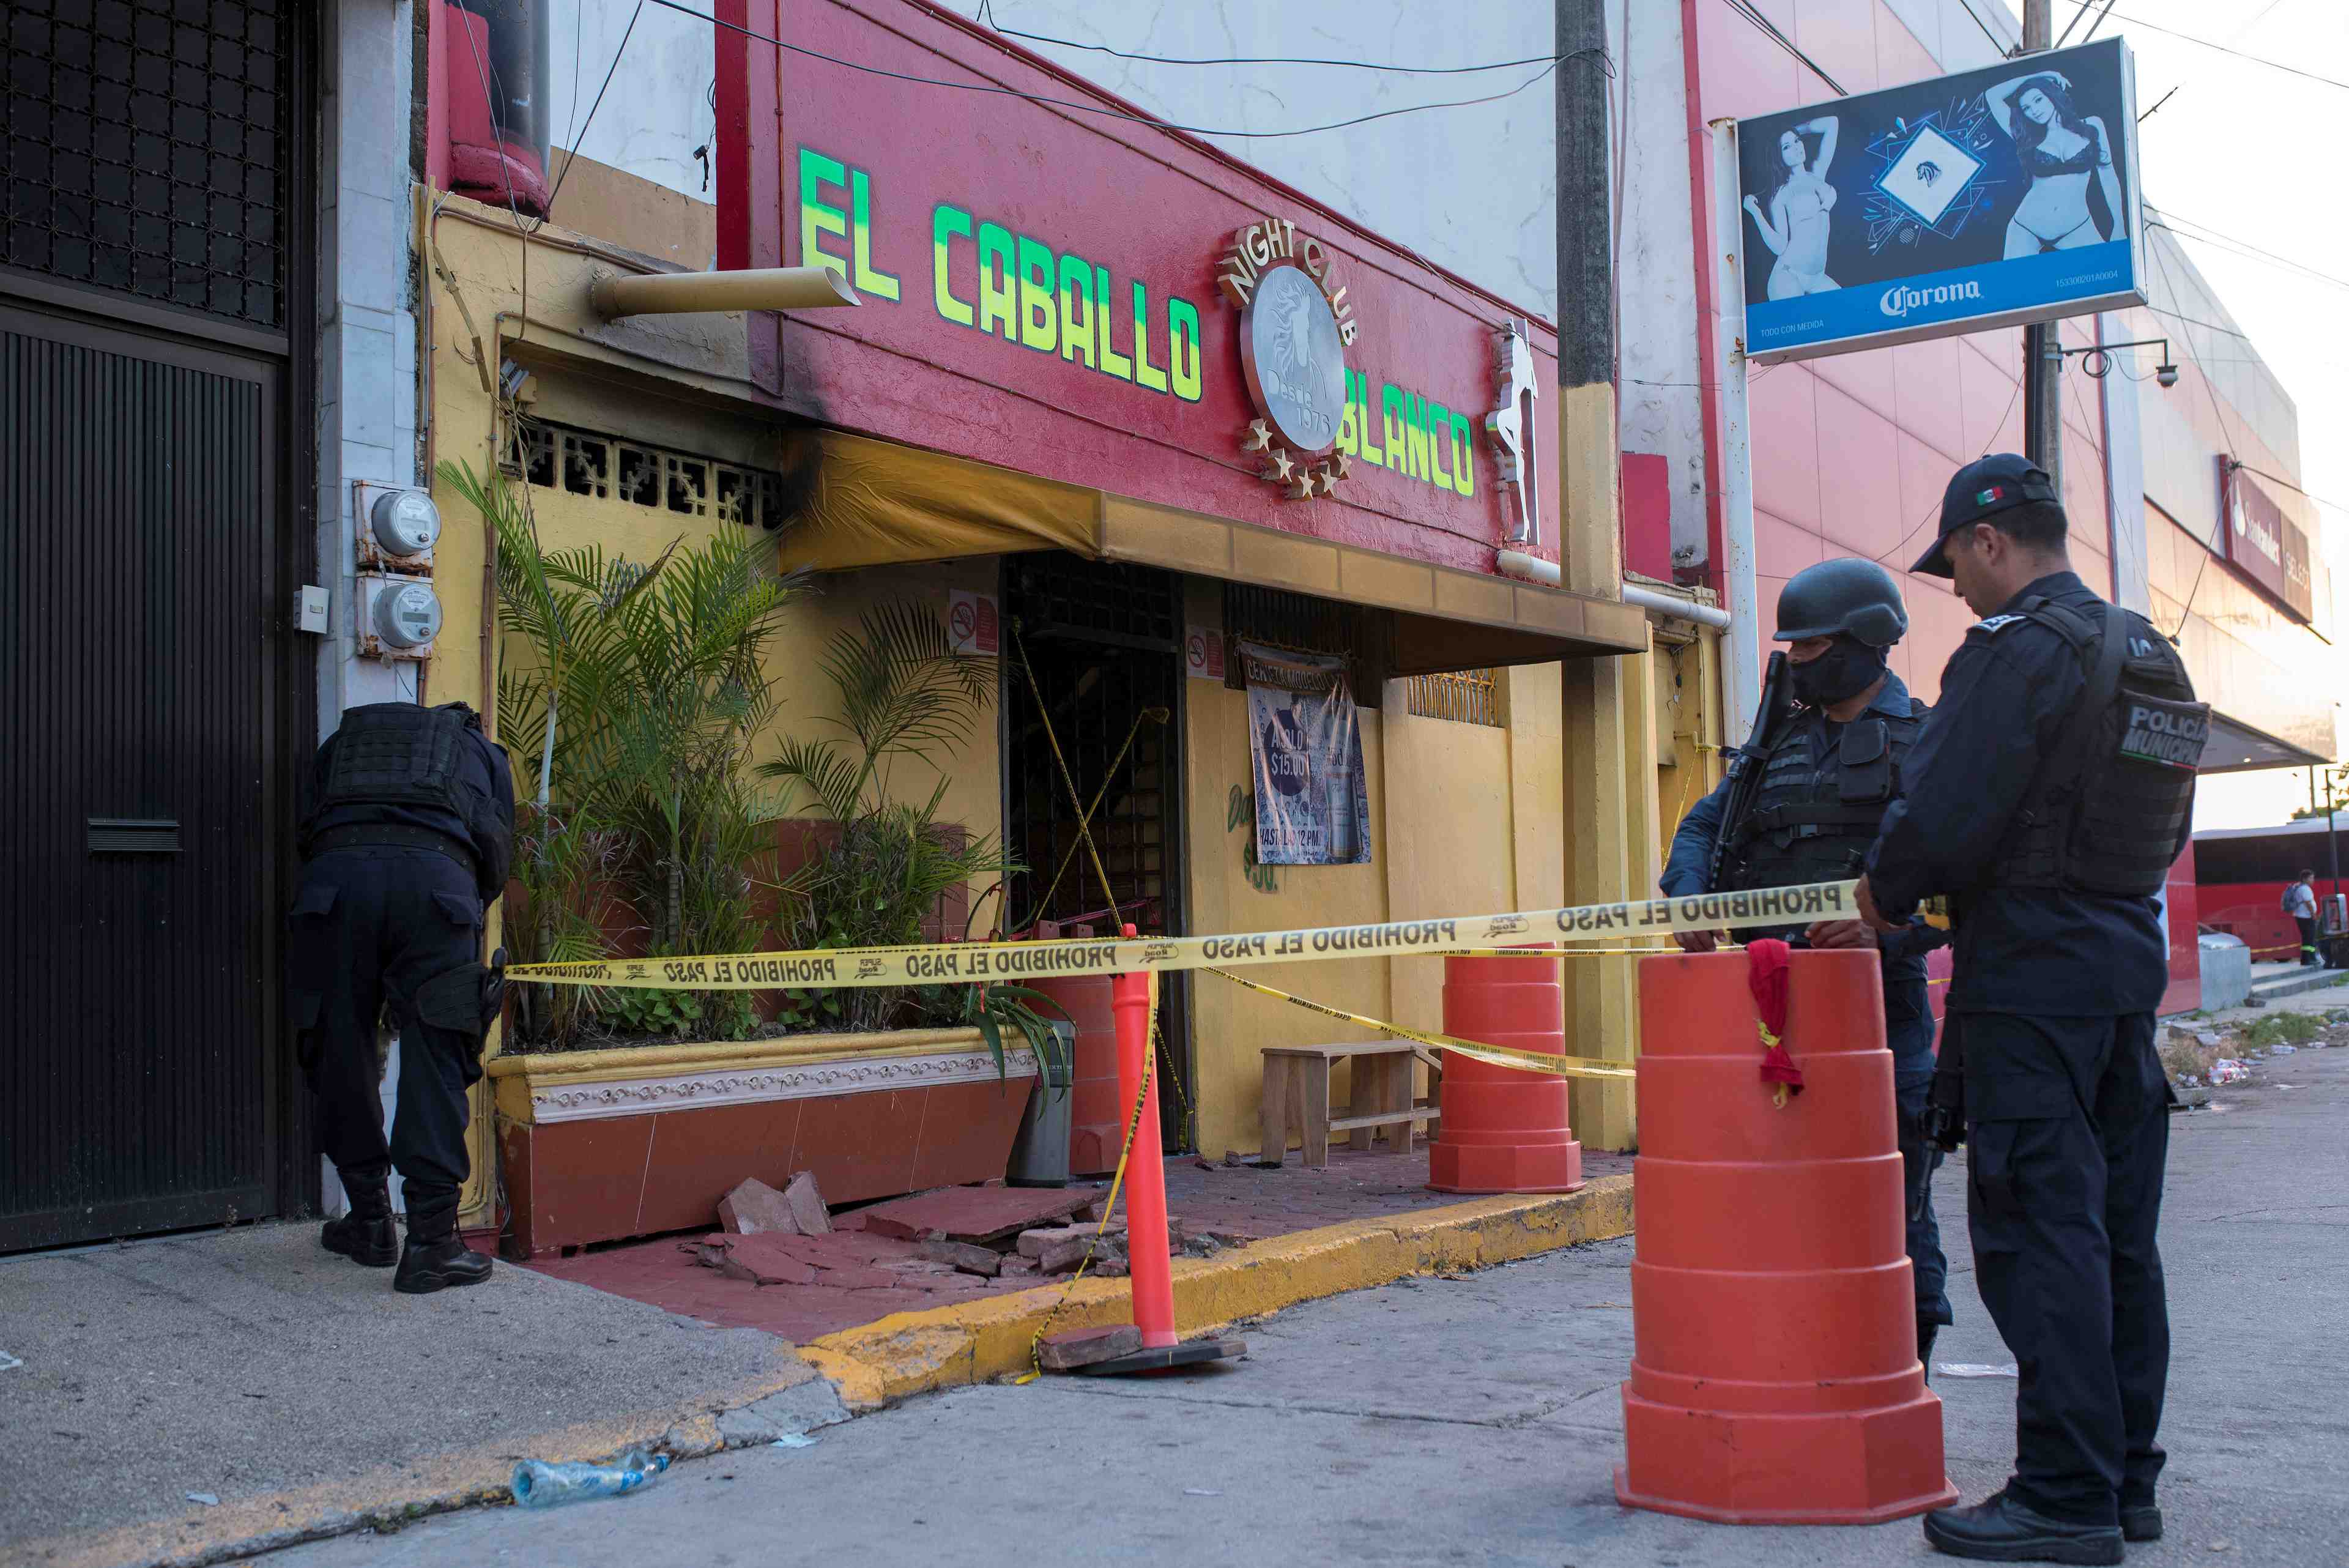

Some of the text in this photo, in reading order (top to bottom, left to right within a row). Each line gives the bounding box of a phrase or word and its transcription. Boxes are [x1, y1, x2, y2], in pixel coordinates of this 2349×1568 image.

[1225, 218, 1357, 346] NIGHT CLUB
[1880, 281, 1981, 317] Corona
[800, 148, 1474, 497] EL CABALLO BLANCO
[1762, 319, 1824, 337] TODO CON MEDIDA
[1267, 367, 1313, 407] Desde
[1272, 752, 1304, 776] $15.00
